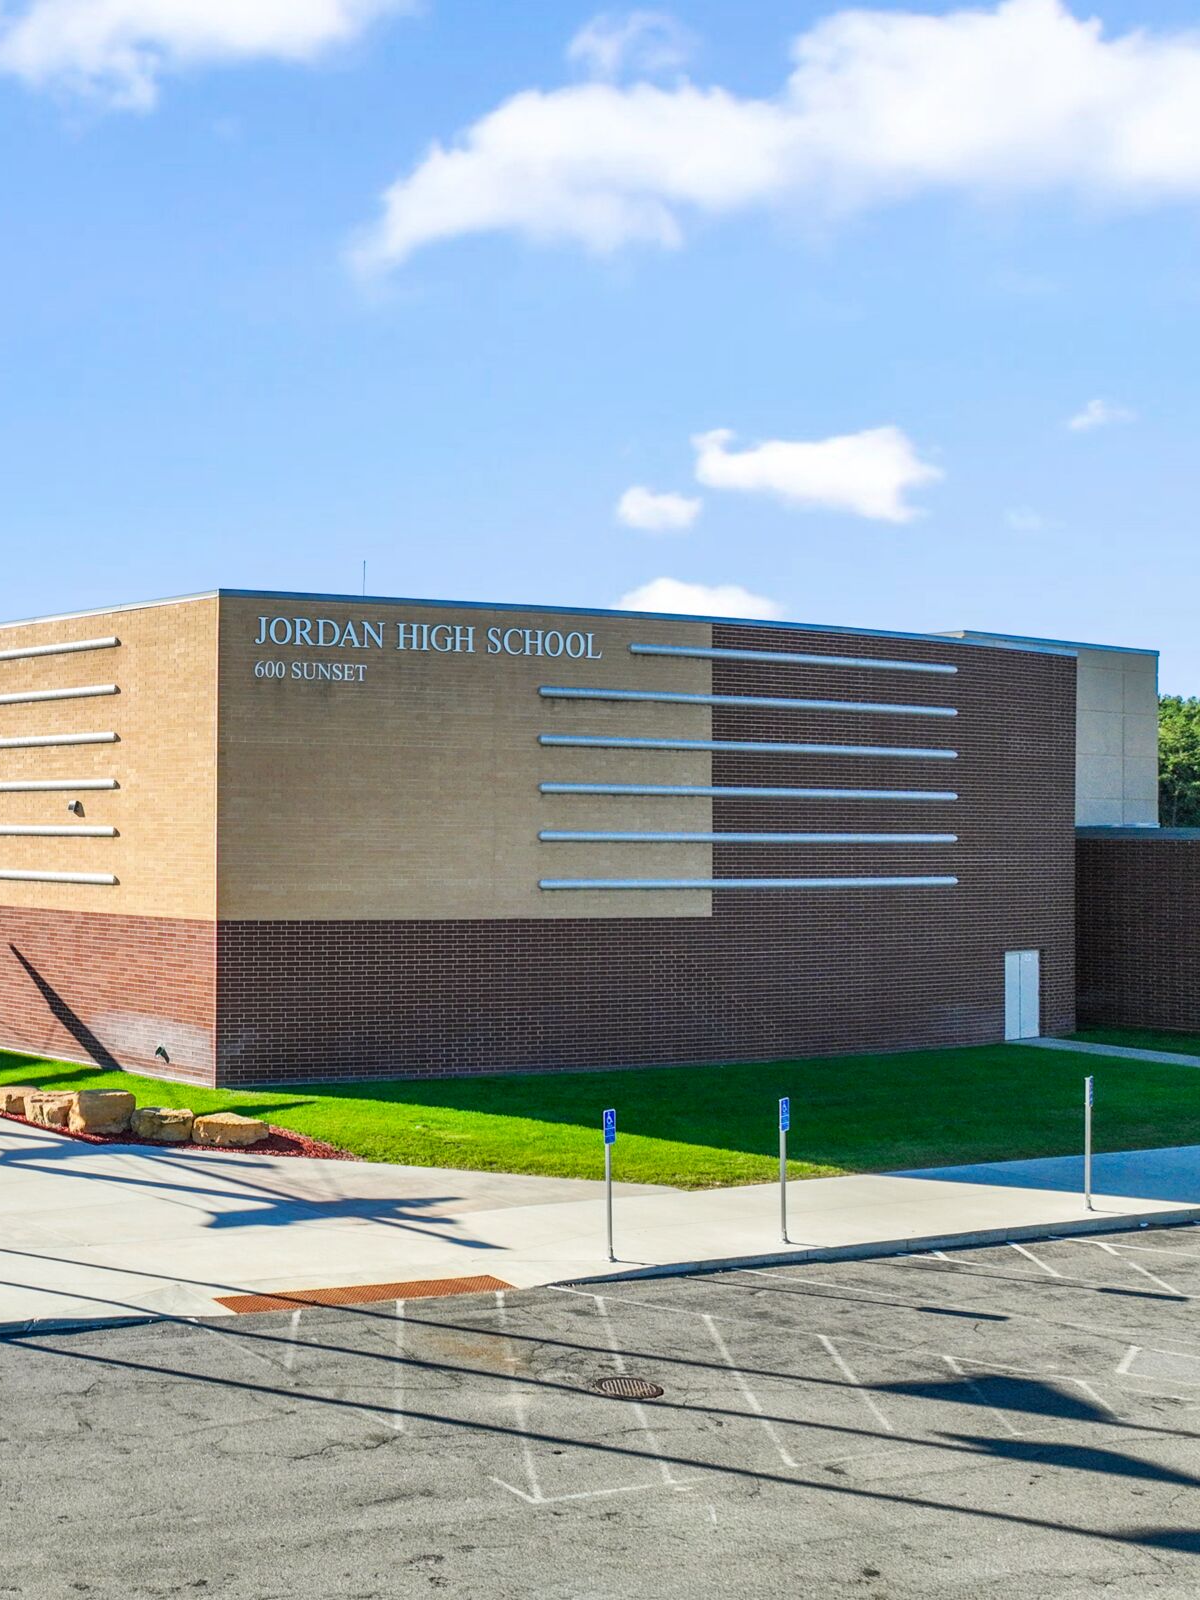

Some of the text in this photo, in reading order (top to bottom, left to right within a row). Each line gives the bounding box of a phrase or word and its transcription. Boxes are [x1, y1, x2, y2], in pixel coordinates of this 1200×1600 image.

[255, 616, 602, 659] JORDAN HIGH SCHOOL
[254, 660, 368, 682] 600 SUNSET
